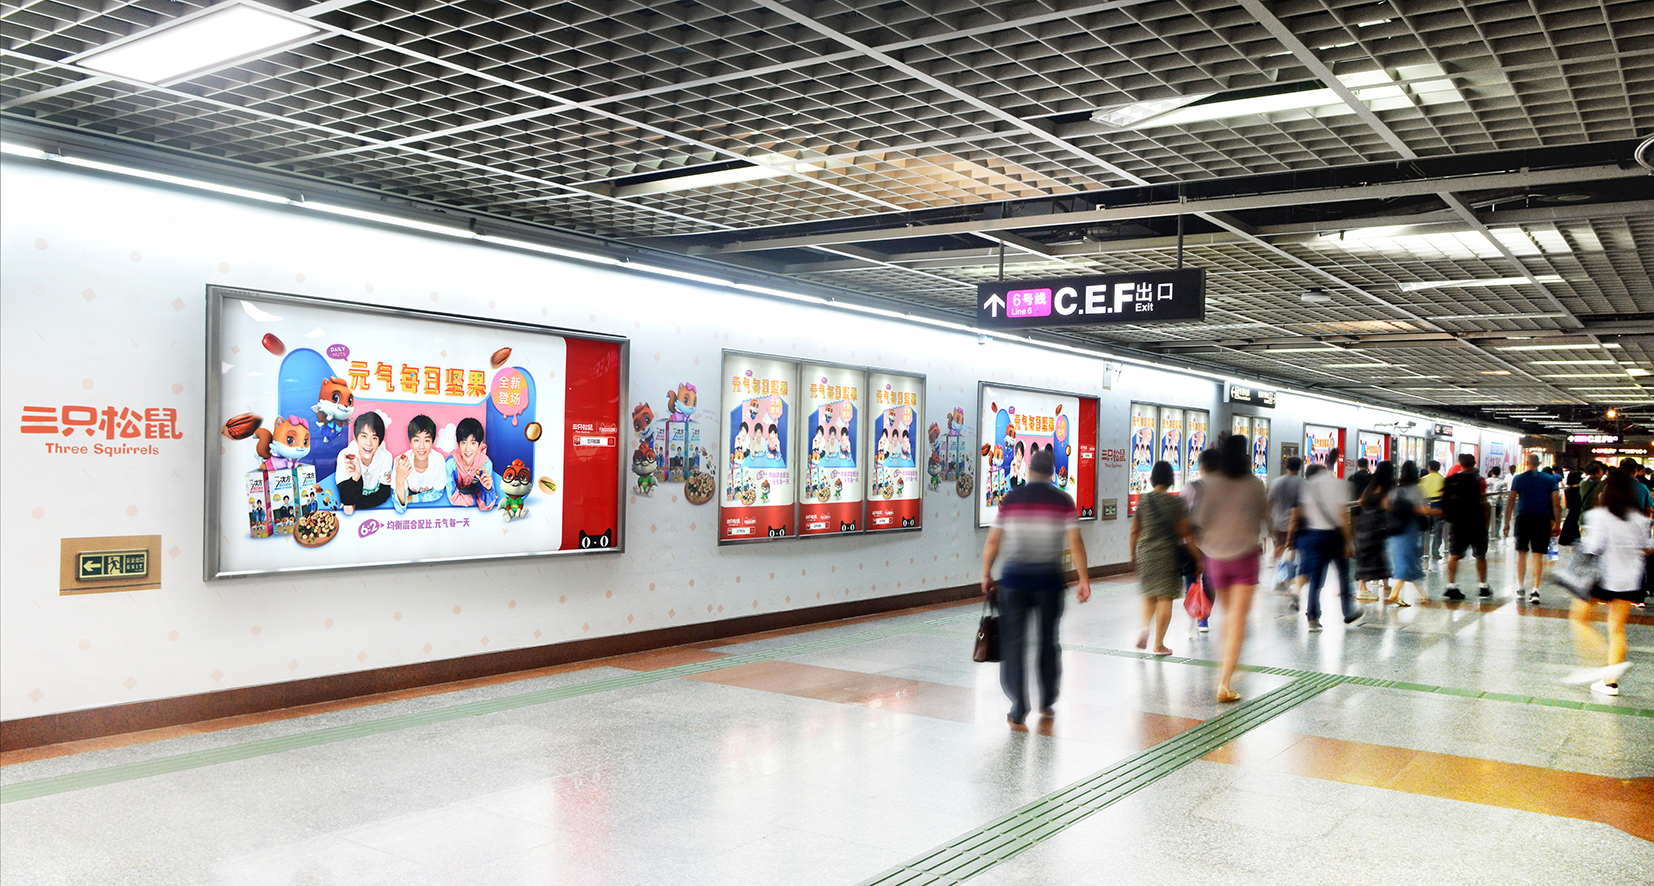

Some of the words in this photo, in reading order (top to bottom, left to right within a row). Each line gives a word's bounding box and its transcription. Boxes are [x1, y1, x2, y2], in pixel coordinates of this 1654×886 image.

[1012, 291, 1047, 307] 6号线
[1054, 282, 1135, 316] C.E.F
[1135, 281, 1173, 303] 出口
[1011, 307, 1026, 315] Line
[1027, 307, 1033, 315] 6
[1135, 302, 1154, 312] Exit
[348, 360, 487, 398] 元气每日坚果
[498, 375, 521, 389] 全新
[732, 376, 789, 396] 元气每日坚果
[498, 391, 521, 406] 登场
[809, 383, 858, 401] 元气每日坚果
[875, 389, 917, 406] 元气每日坚果
[20, 405, 183, 440] 三只松鼠
[45, 442, 88, 454] Three
[93, 443, 159, 457] Squirrels
